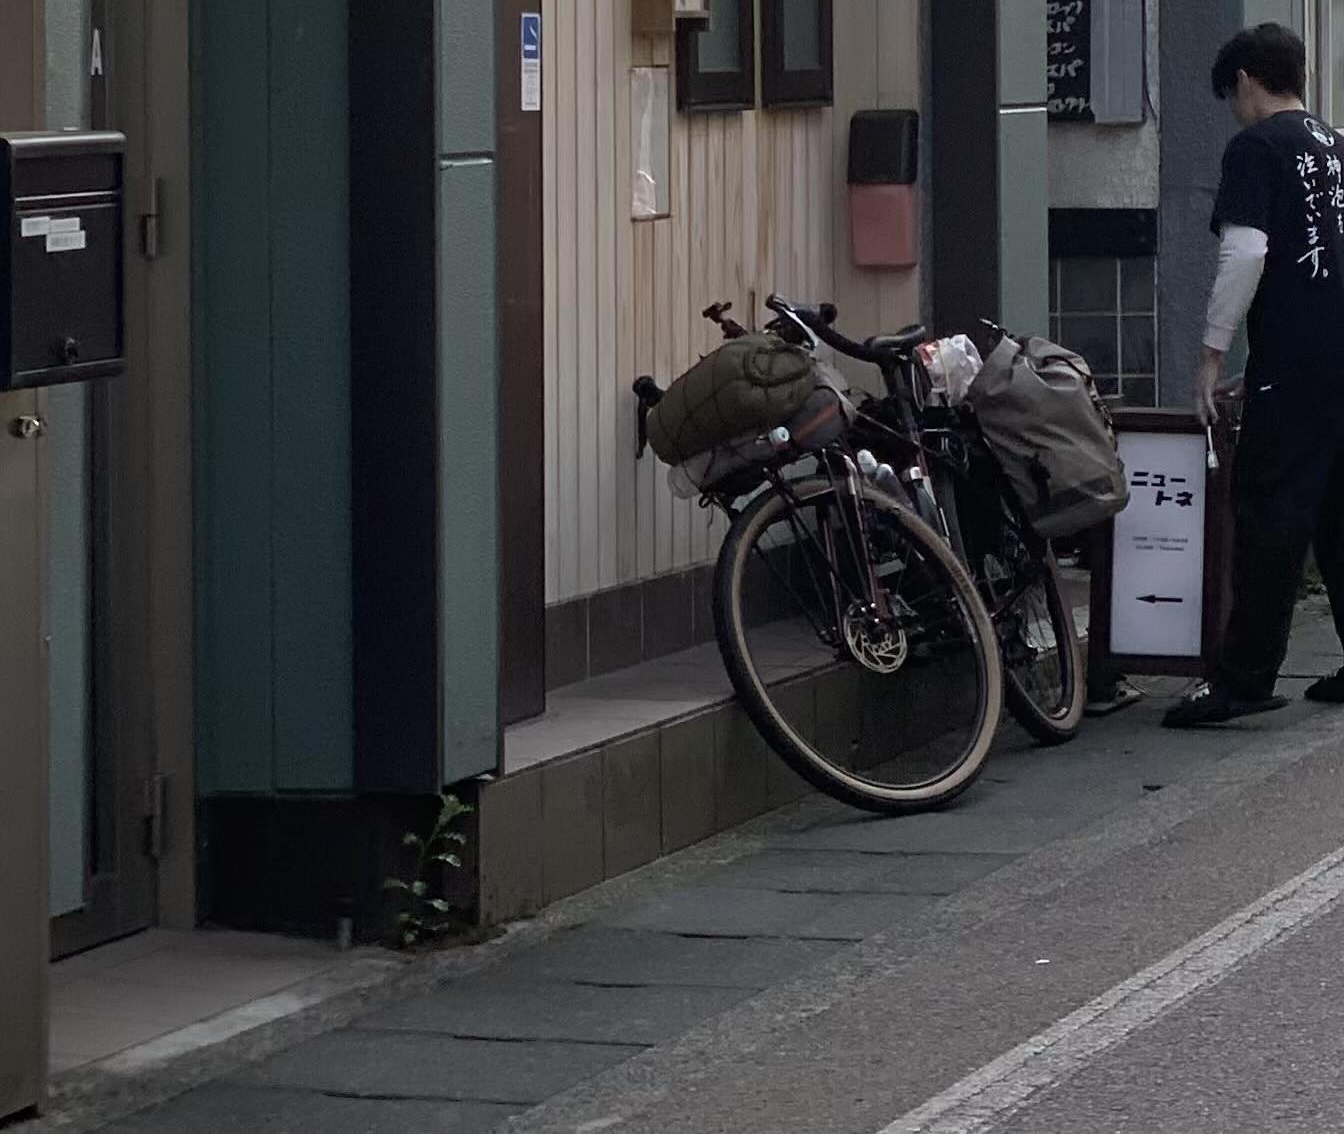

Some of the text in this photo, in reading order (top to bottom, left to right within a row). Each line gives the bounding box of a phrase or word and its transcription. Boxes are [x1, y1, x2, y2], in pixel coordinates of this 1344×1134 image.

[1296, 151, 1329, 279] 注いでいます。
[1130, 471, 1186, 487] ニュー
[1154, 490, 1193, 507] トネ
